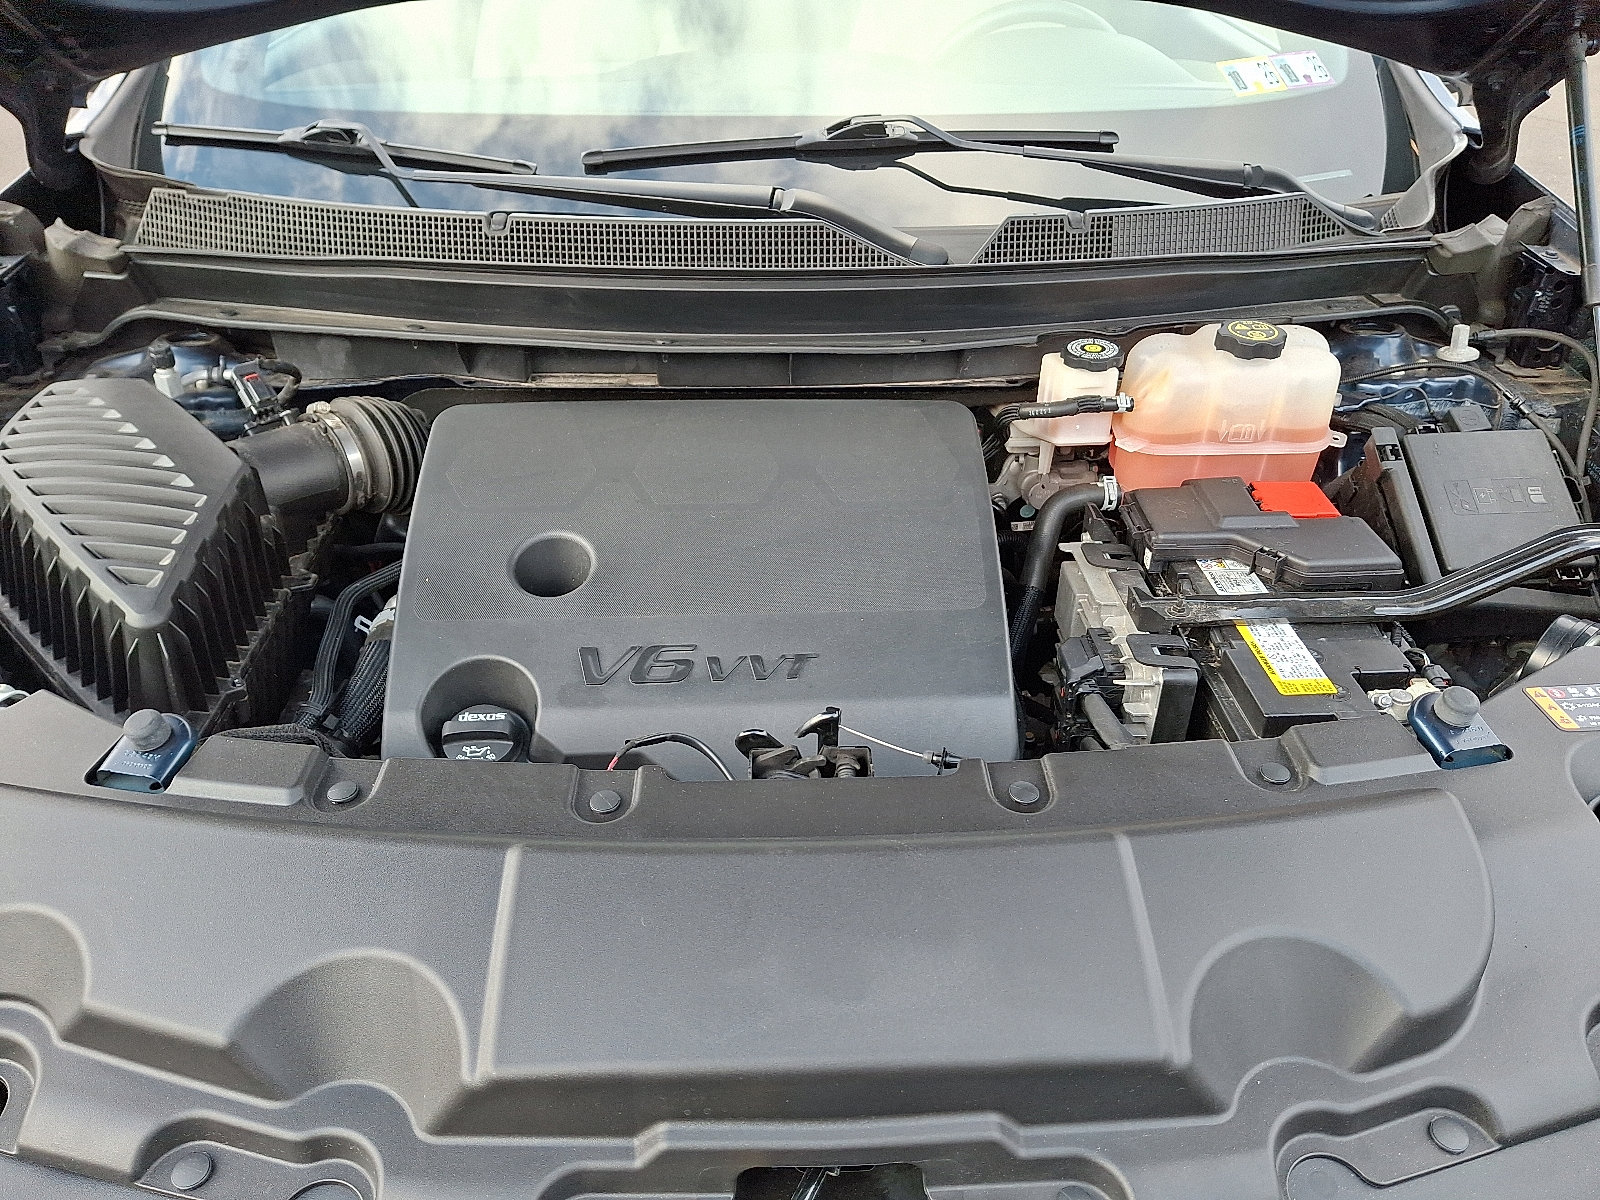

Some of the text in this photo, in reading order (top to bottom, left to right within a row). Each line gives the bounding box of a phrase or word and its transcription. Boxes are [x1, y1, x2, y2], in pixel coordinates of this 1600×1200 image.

[578, 643, 821, 686] V6 VVT
[458, 711, 508, 722] dexos
